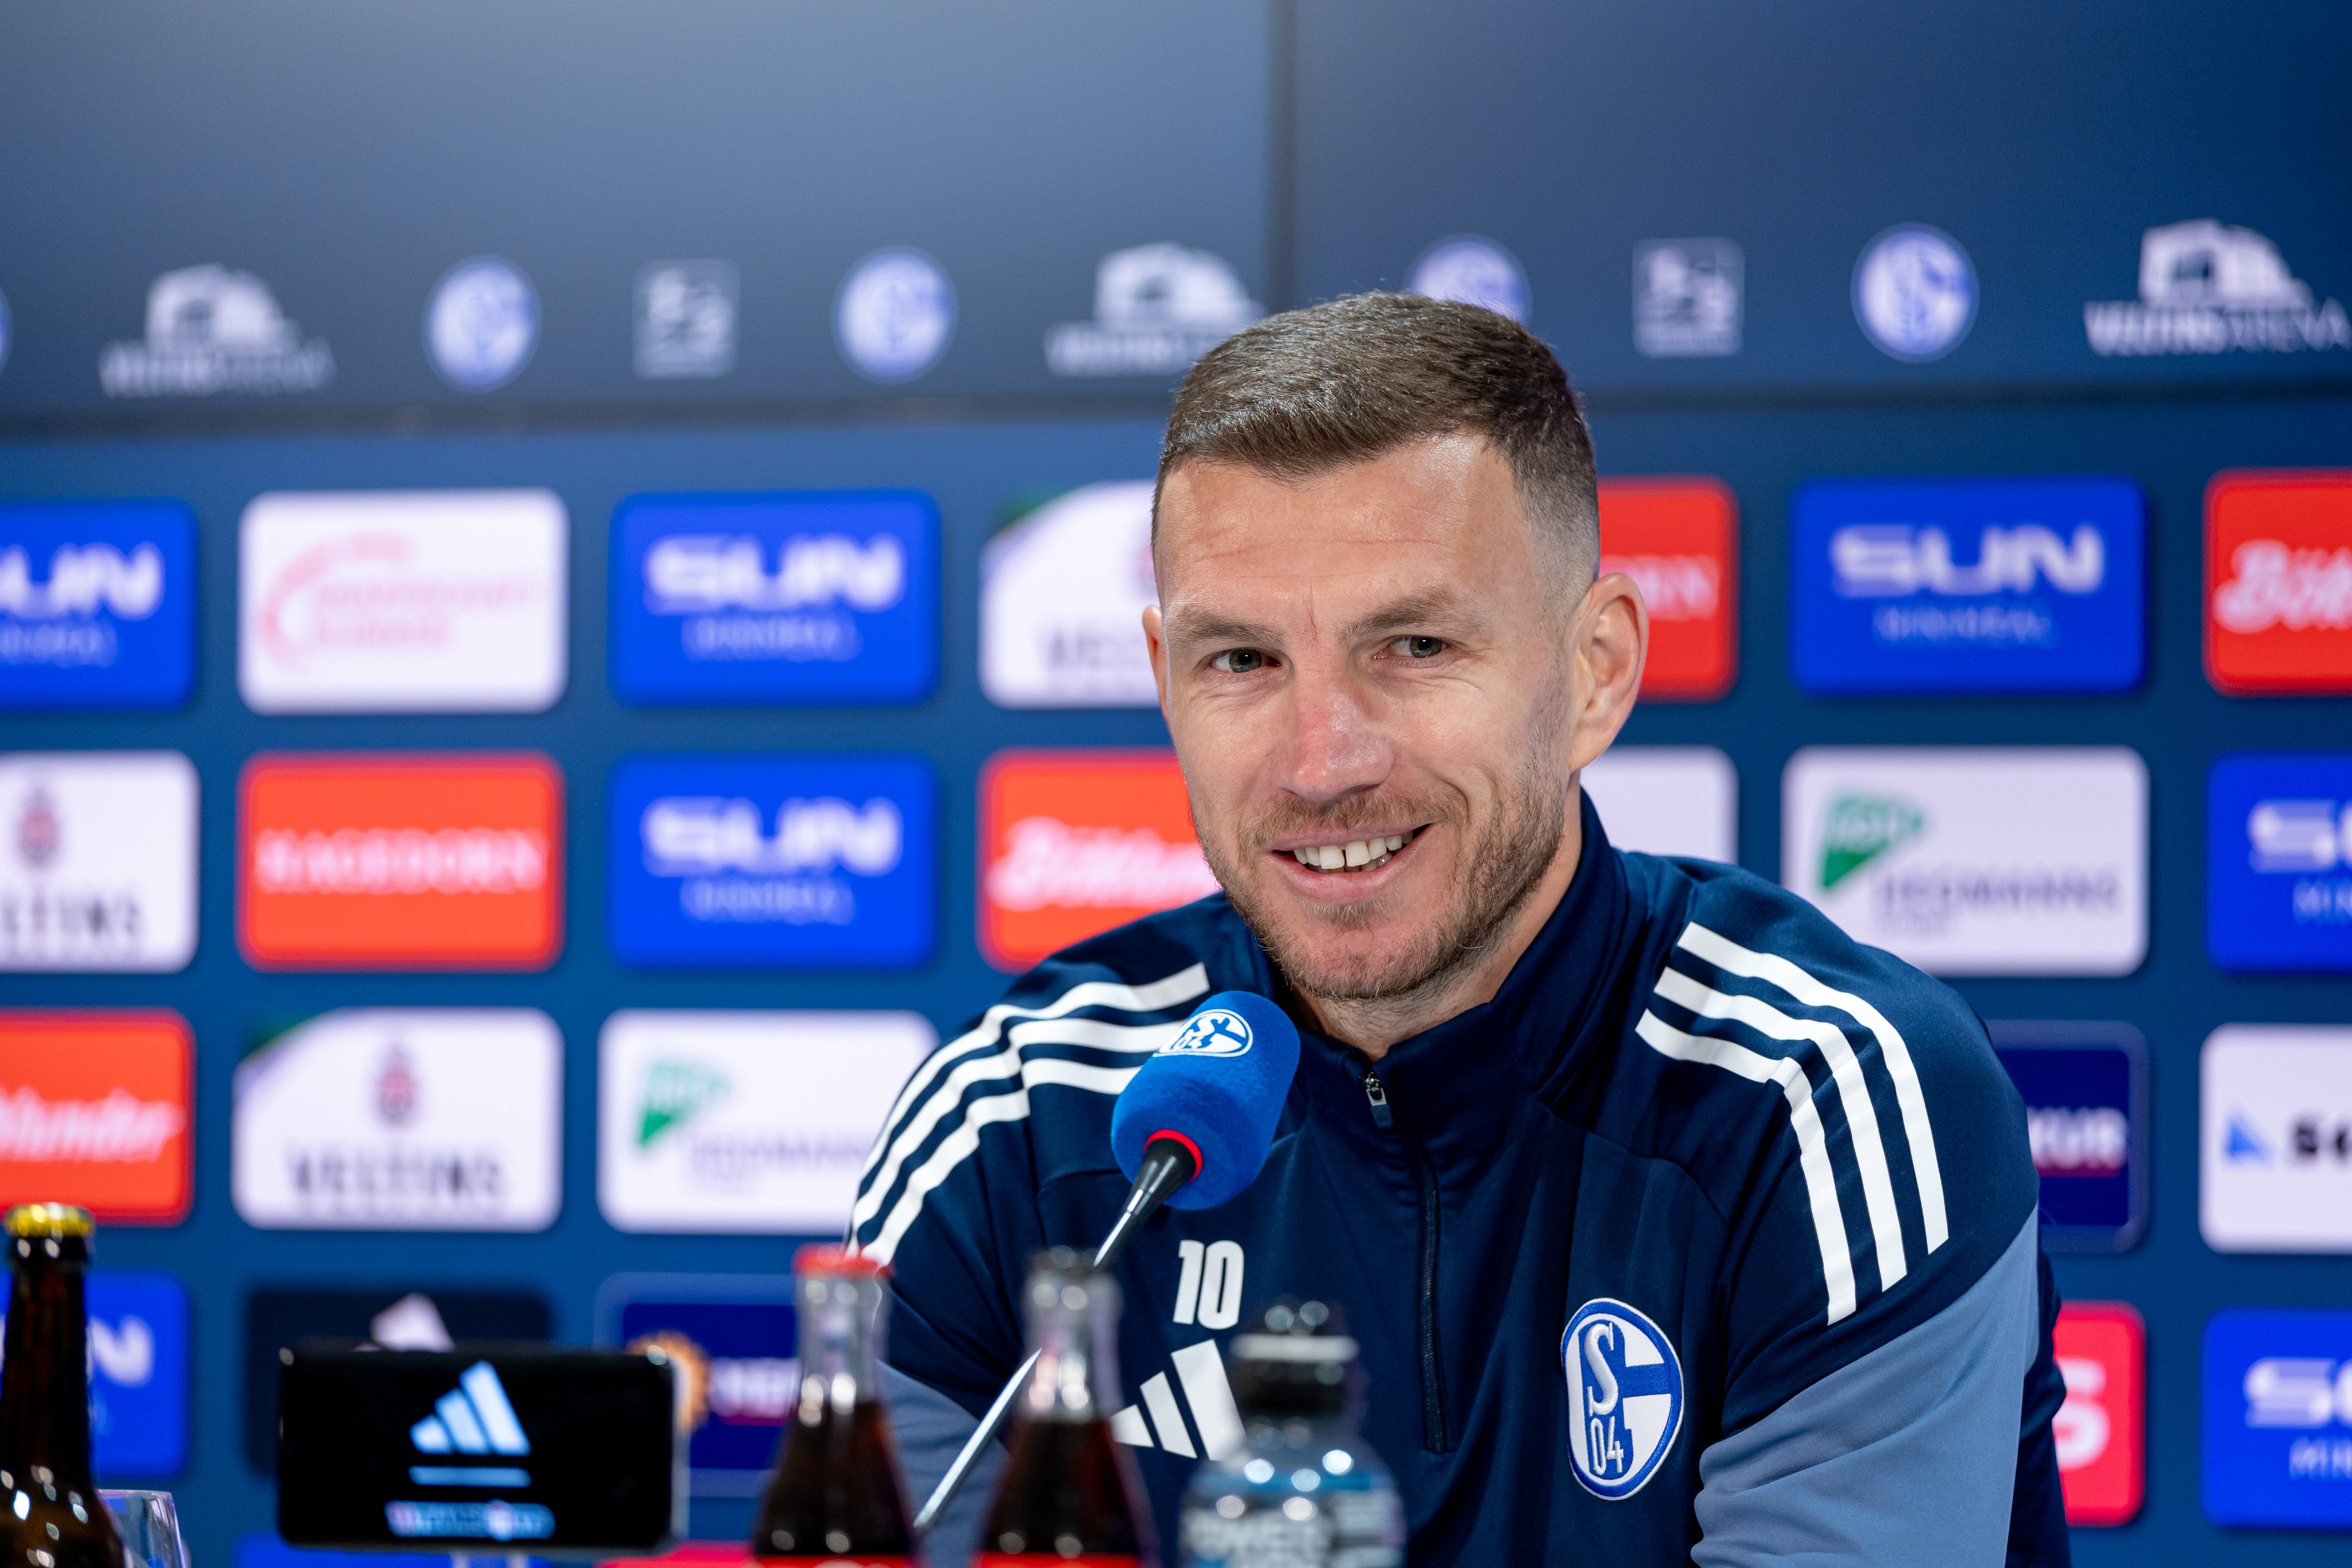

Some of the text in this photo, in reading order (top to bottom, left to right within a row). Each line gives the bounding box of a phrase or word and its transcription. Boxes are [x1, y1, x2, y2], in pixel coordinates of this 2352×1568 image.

[0, 541, 165, 620] UN
[644, 534, 905, 614] SUN
[1832, 522, 2106, 597] SUN
[641, 796, 903, 876] SUN
[2247, 800, 2352, 873] S
[0, 885, 142, 939] LTINS
[2027, 1107, 2127, 1169] KUR
[1173, 1239, 1244, 1330] 10
[1584, 1322, 1619, 1416] S
[2243, 1356, 2352, 1428] S
[1589, 1416, 1624, 1475] 04
